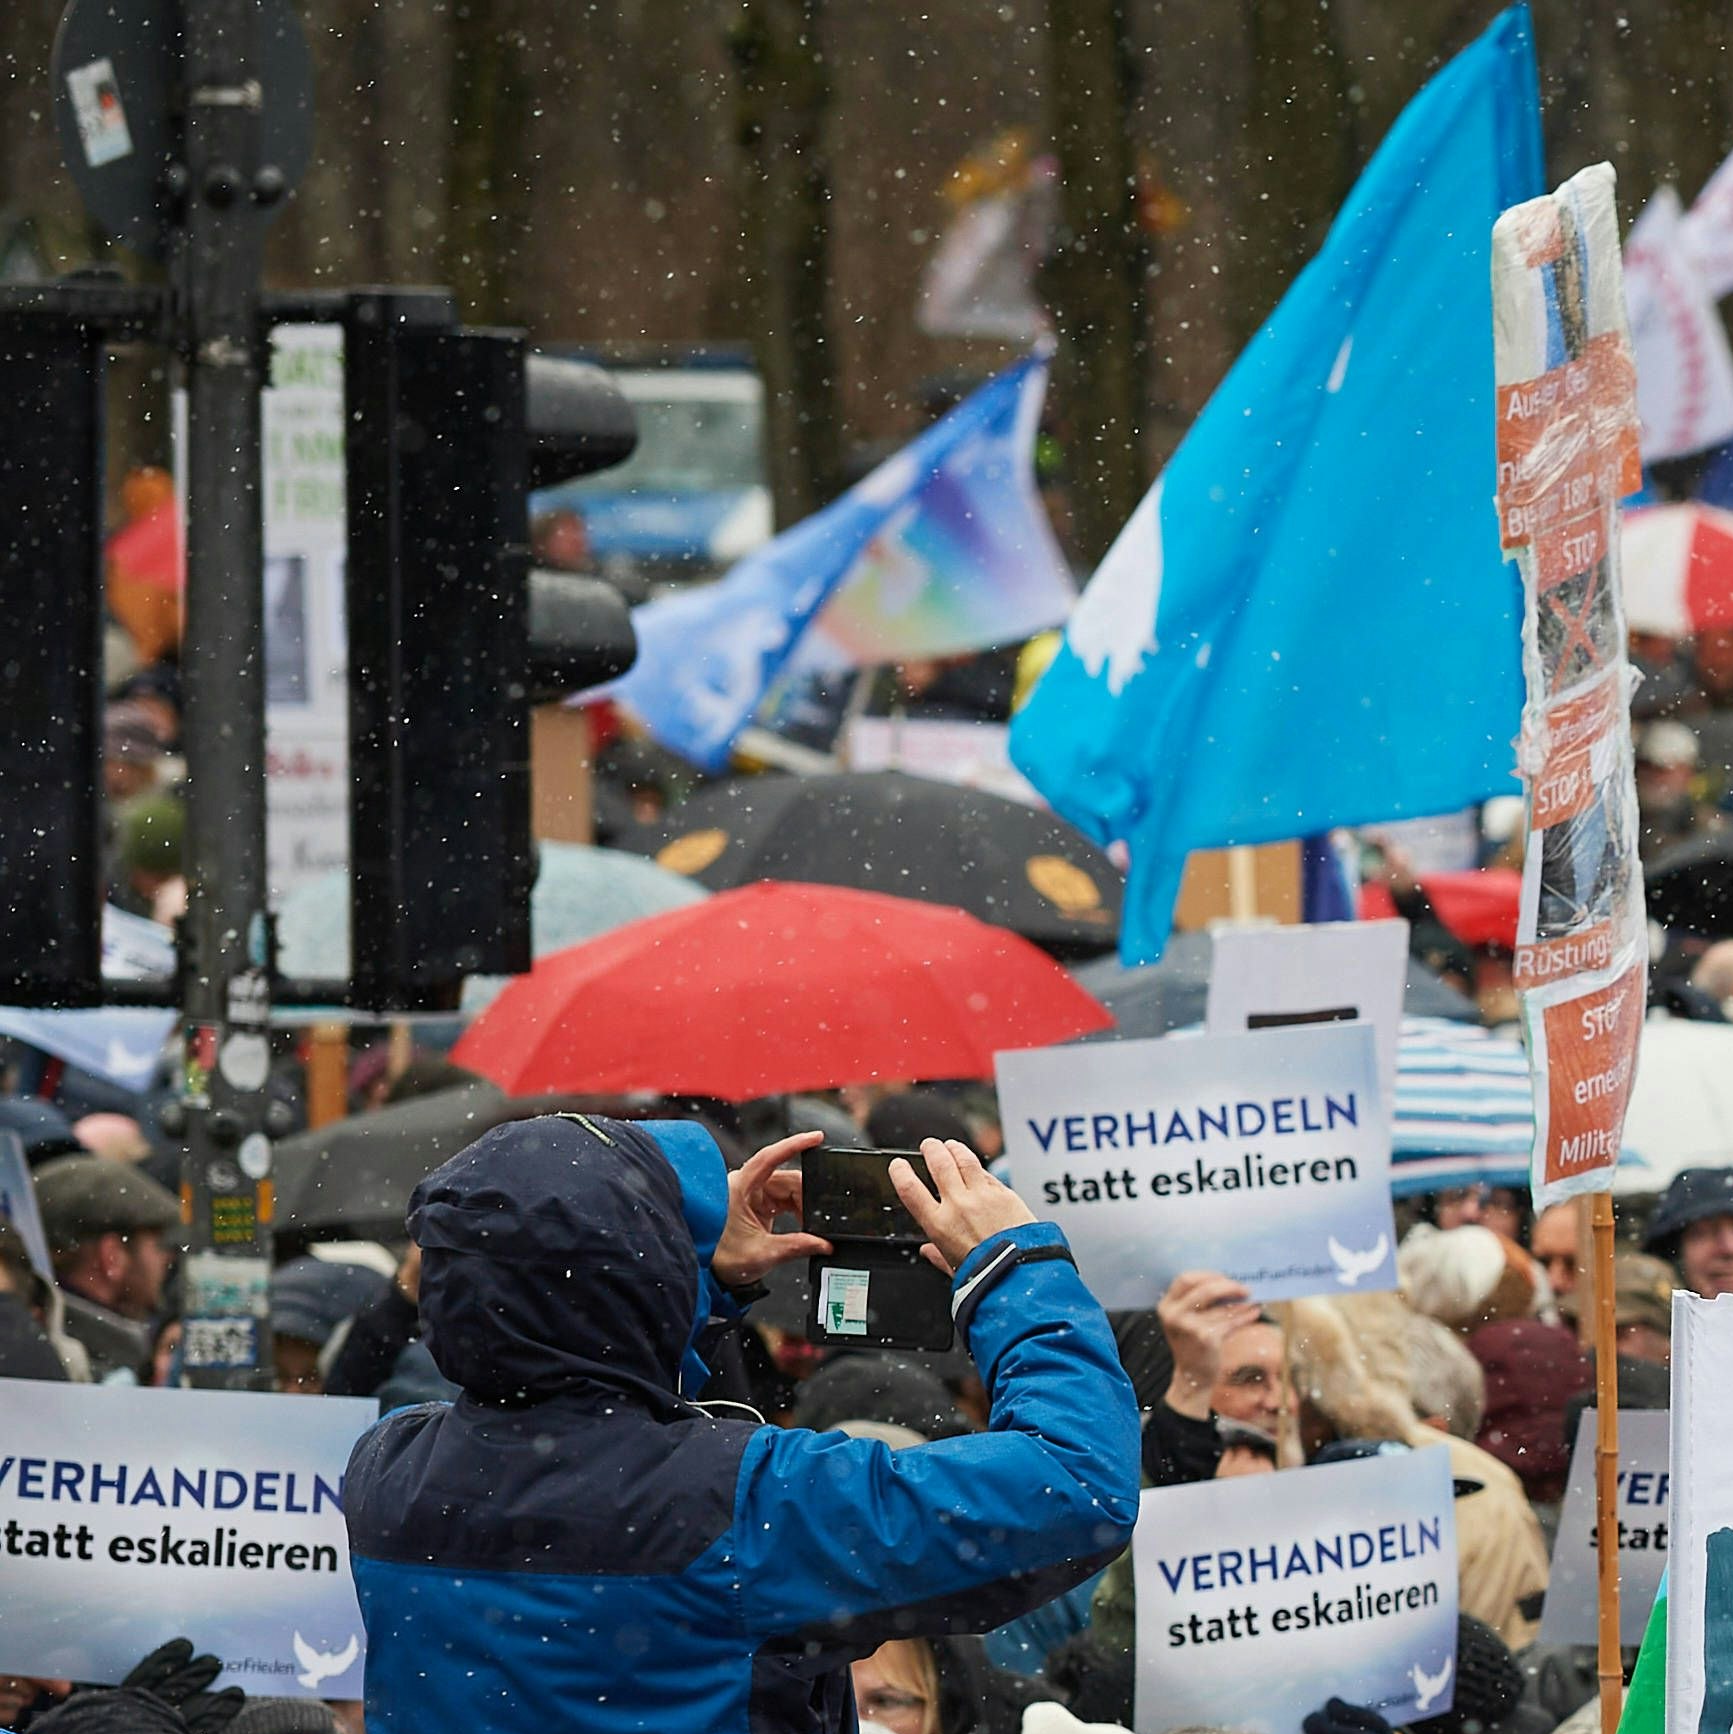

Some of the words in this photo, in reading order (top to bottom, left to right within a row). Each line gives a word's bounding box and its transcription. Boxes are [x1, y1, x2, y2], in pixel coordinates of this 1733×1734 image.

[1027, 1093, 1359, 1153] VERHANDELN
[1043, 1167, 1138, 1205] statt
[1151, 1154, 1358, 1197] eskalieren
[0, 1520, 94, 1560] tatt
[108, 1526, 339, 1572] eskalieren
[1158, 1516, 1441, 1594] VERHANDELN
[1168, 1605, 1260, 1648] statt
[1271, 1581, 1439, 1632] eskalieren
